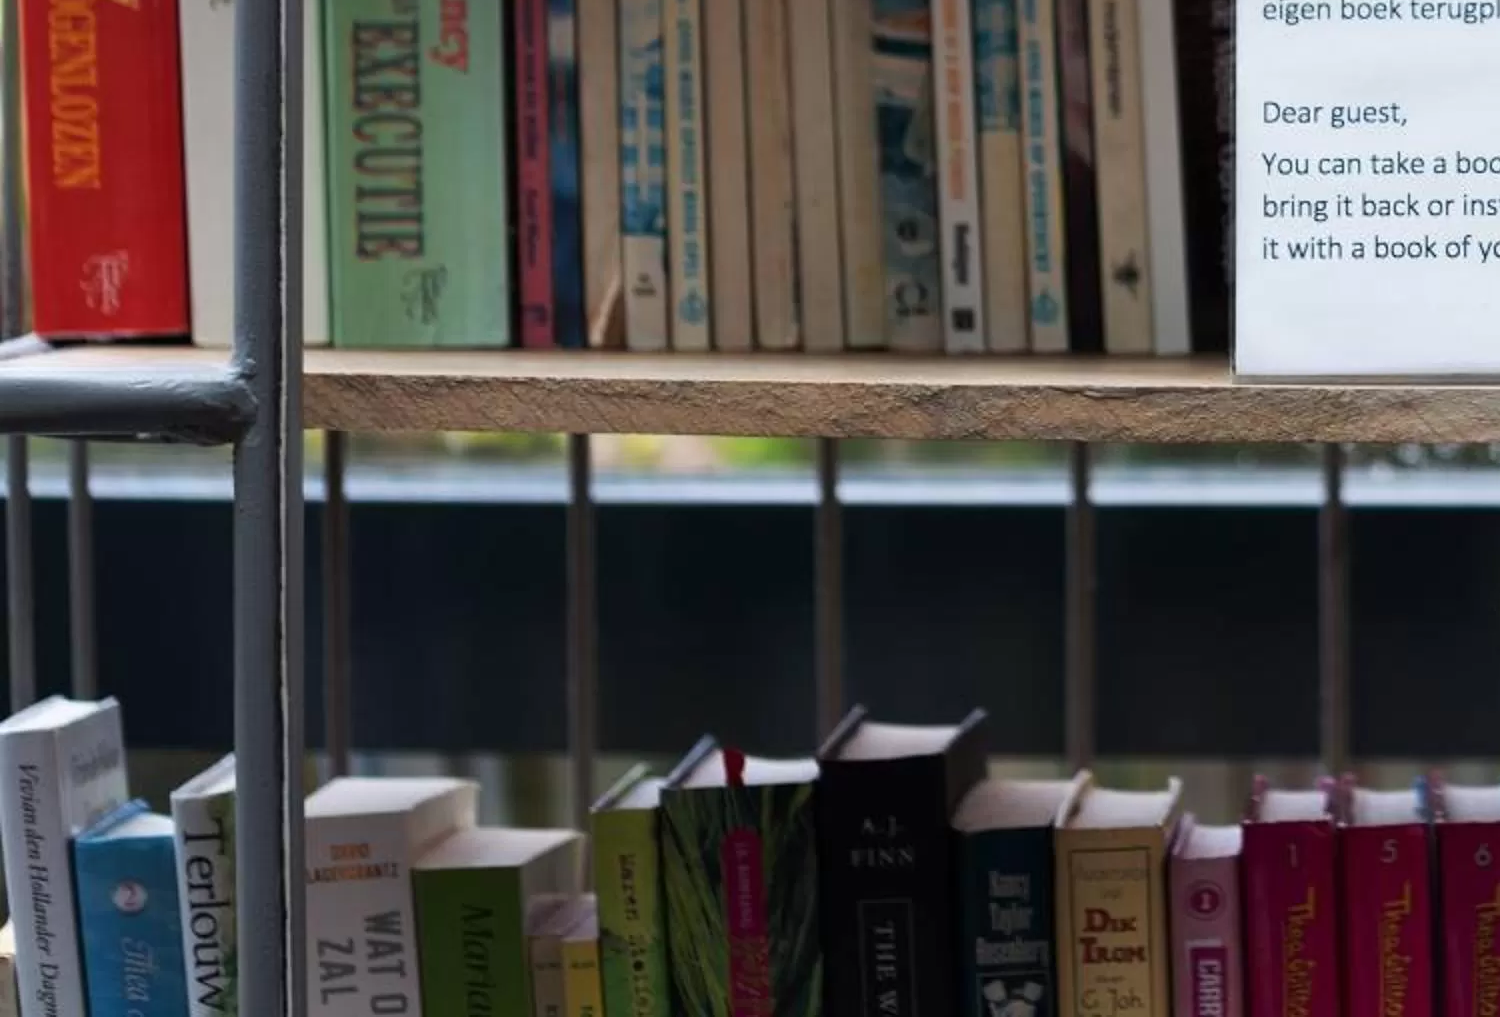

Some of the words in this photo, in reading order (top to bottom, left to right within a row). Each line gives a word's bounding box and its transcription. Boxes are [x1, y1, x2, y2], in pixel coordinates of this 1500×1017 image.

[1263, 100, 1325, 125] Dear
[1330, 102, 1408, 130] guest,
[351, 19, 425, 261] EXECUTIE
[1261, 152, 1310, 176] You
[1317, 157, 1362, 176] can
[1369, 150, 1426, 176] take
[1432, 156, 1448, 175] a
[1262, 192, 1329, 224] bring
[1336, 193, 1354, 218] it
[1361, 191, 1421, 218] back
[1426, 198, 1456, 218] or
[1262, 236, 1280, 261] it
[1286, 234, 1343, 261] with
[1350, 241, 1366, 261] a
[1373, 234, 1438, 261] book
[1444, 233, 1473, 260] of
[18, 764, 41, 824] Vivian
[24, 828, 45, 860] den
[850, 844, 916, 869] FINN
[1287, 843, 1298, 868] 1
[1380, 839, 1398, 864] 5
[1474, 842, 1493, 867] 6
[28, 863, 53, 954] Hollander
[183, 817, 230, 1012] Terlouw
[364, 909, 407, 978] WAT
[460, 902, 497, 1017] Maria
[873, 919, 898, 982] THE
[317, 937, 360, 1005] ZAL
